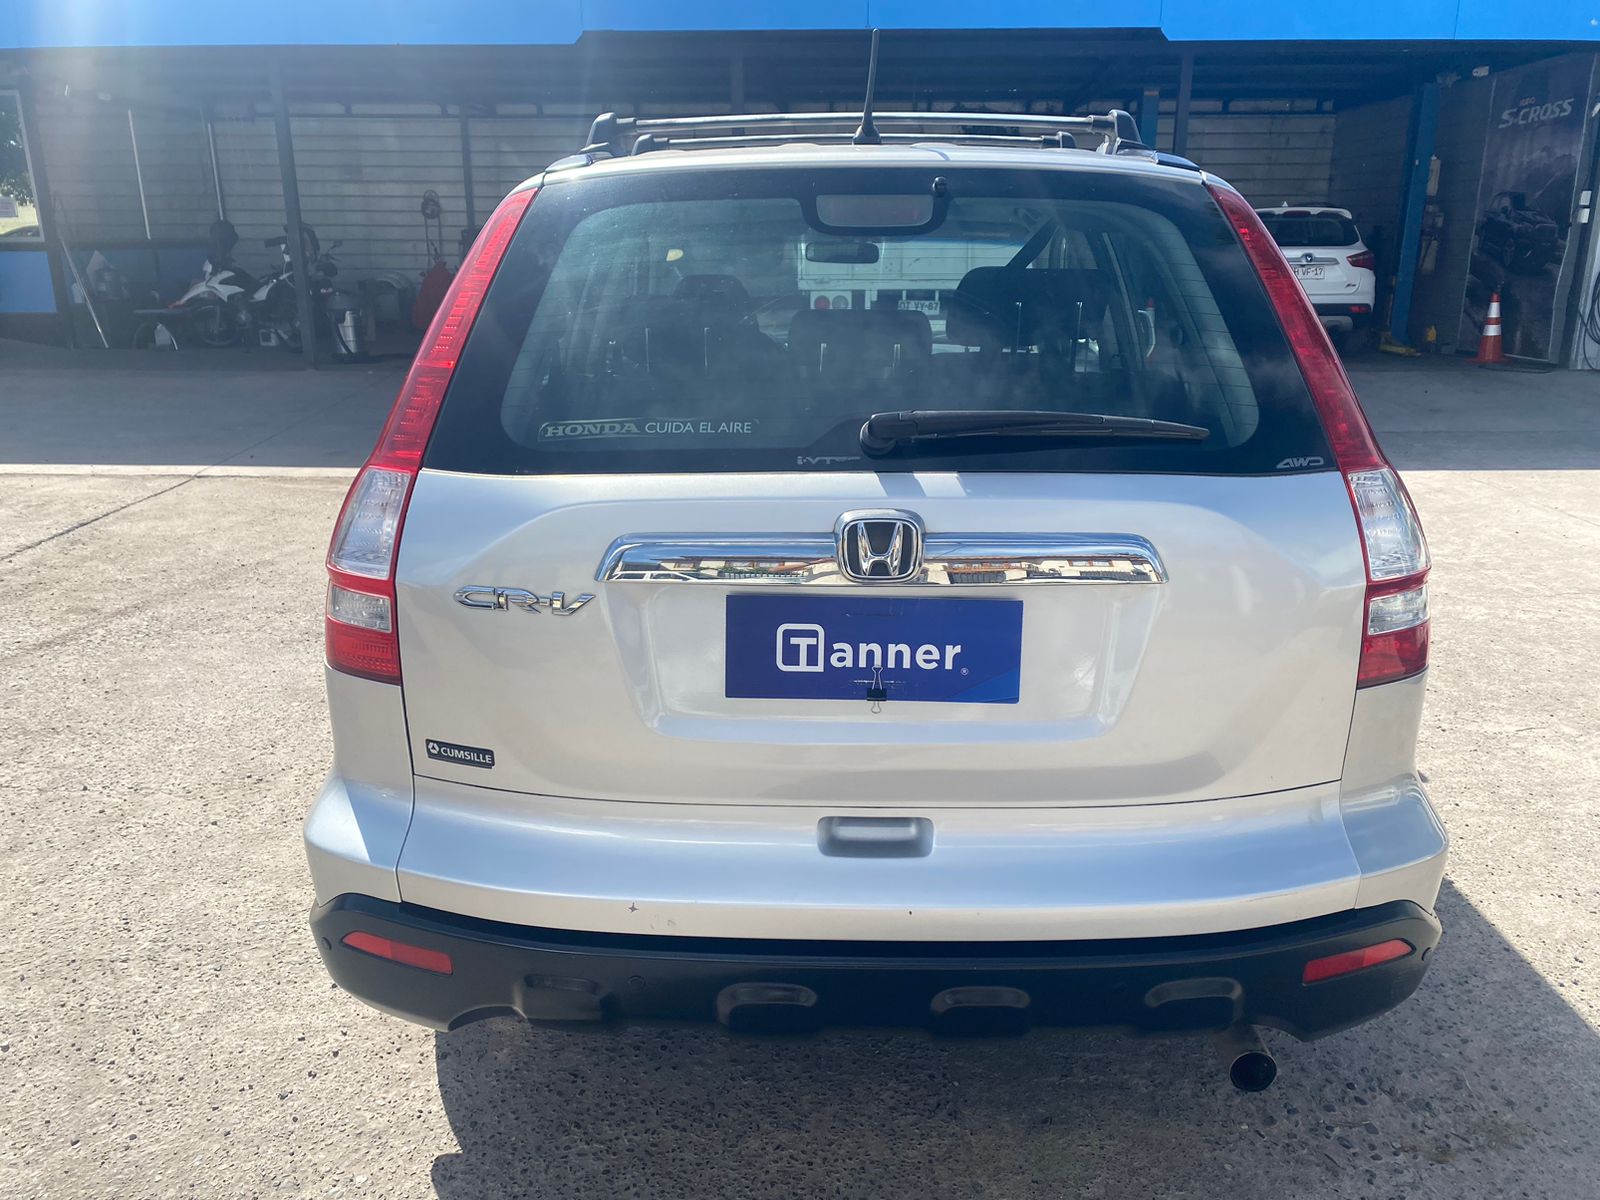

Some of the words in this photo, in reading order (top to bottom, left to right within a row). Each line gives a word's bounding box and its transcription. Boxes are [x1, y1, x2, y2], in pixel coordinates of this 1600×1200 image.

[545, 422, 640, 438] HONDA
[645, 421, 695, 434] CUIDA
[699, 421, 716, 434] EL
[717, 421, 753, 434] AIRE
[1276, 456, 1324, 469] 4WD
[453, 585, 597, 616] CR-V
[440, 747, 492, 764] CUMSILLE
